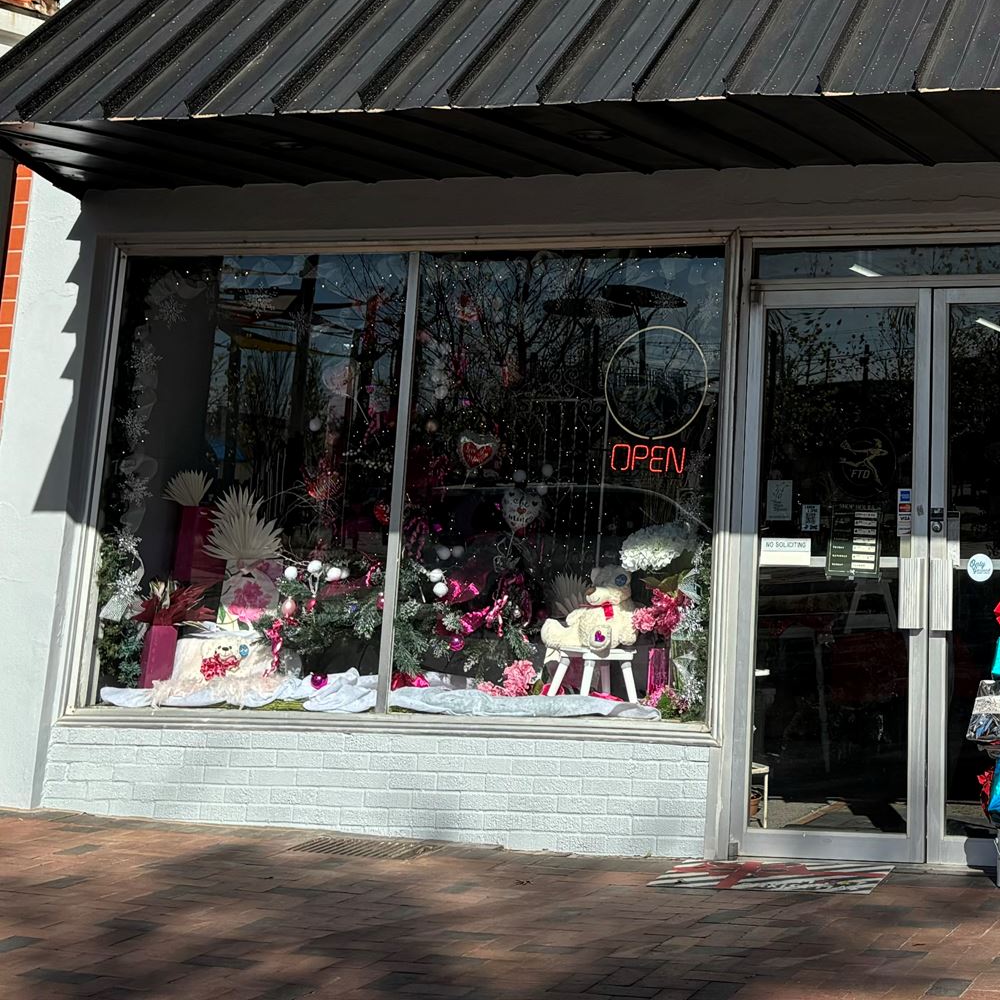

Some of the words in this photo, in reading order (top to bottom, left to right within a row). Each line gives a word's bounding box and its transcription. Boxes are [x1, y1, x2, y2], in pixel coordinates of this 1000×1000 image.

[611, 443, 686, 474] OPEN
[850, 469, 870, 479] FTD
[775, 541, 807, 549] SOLICITING
